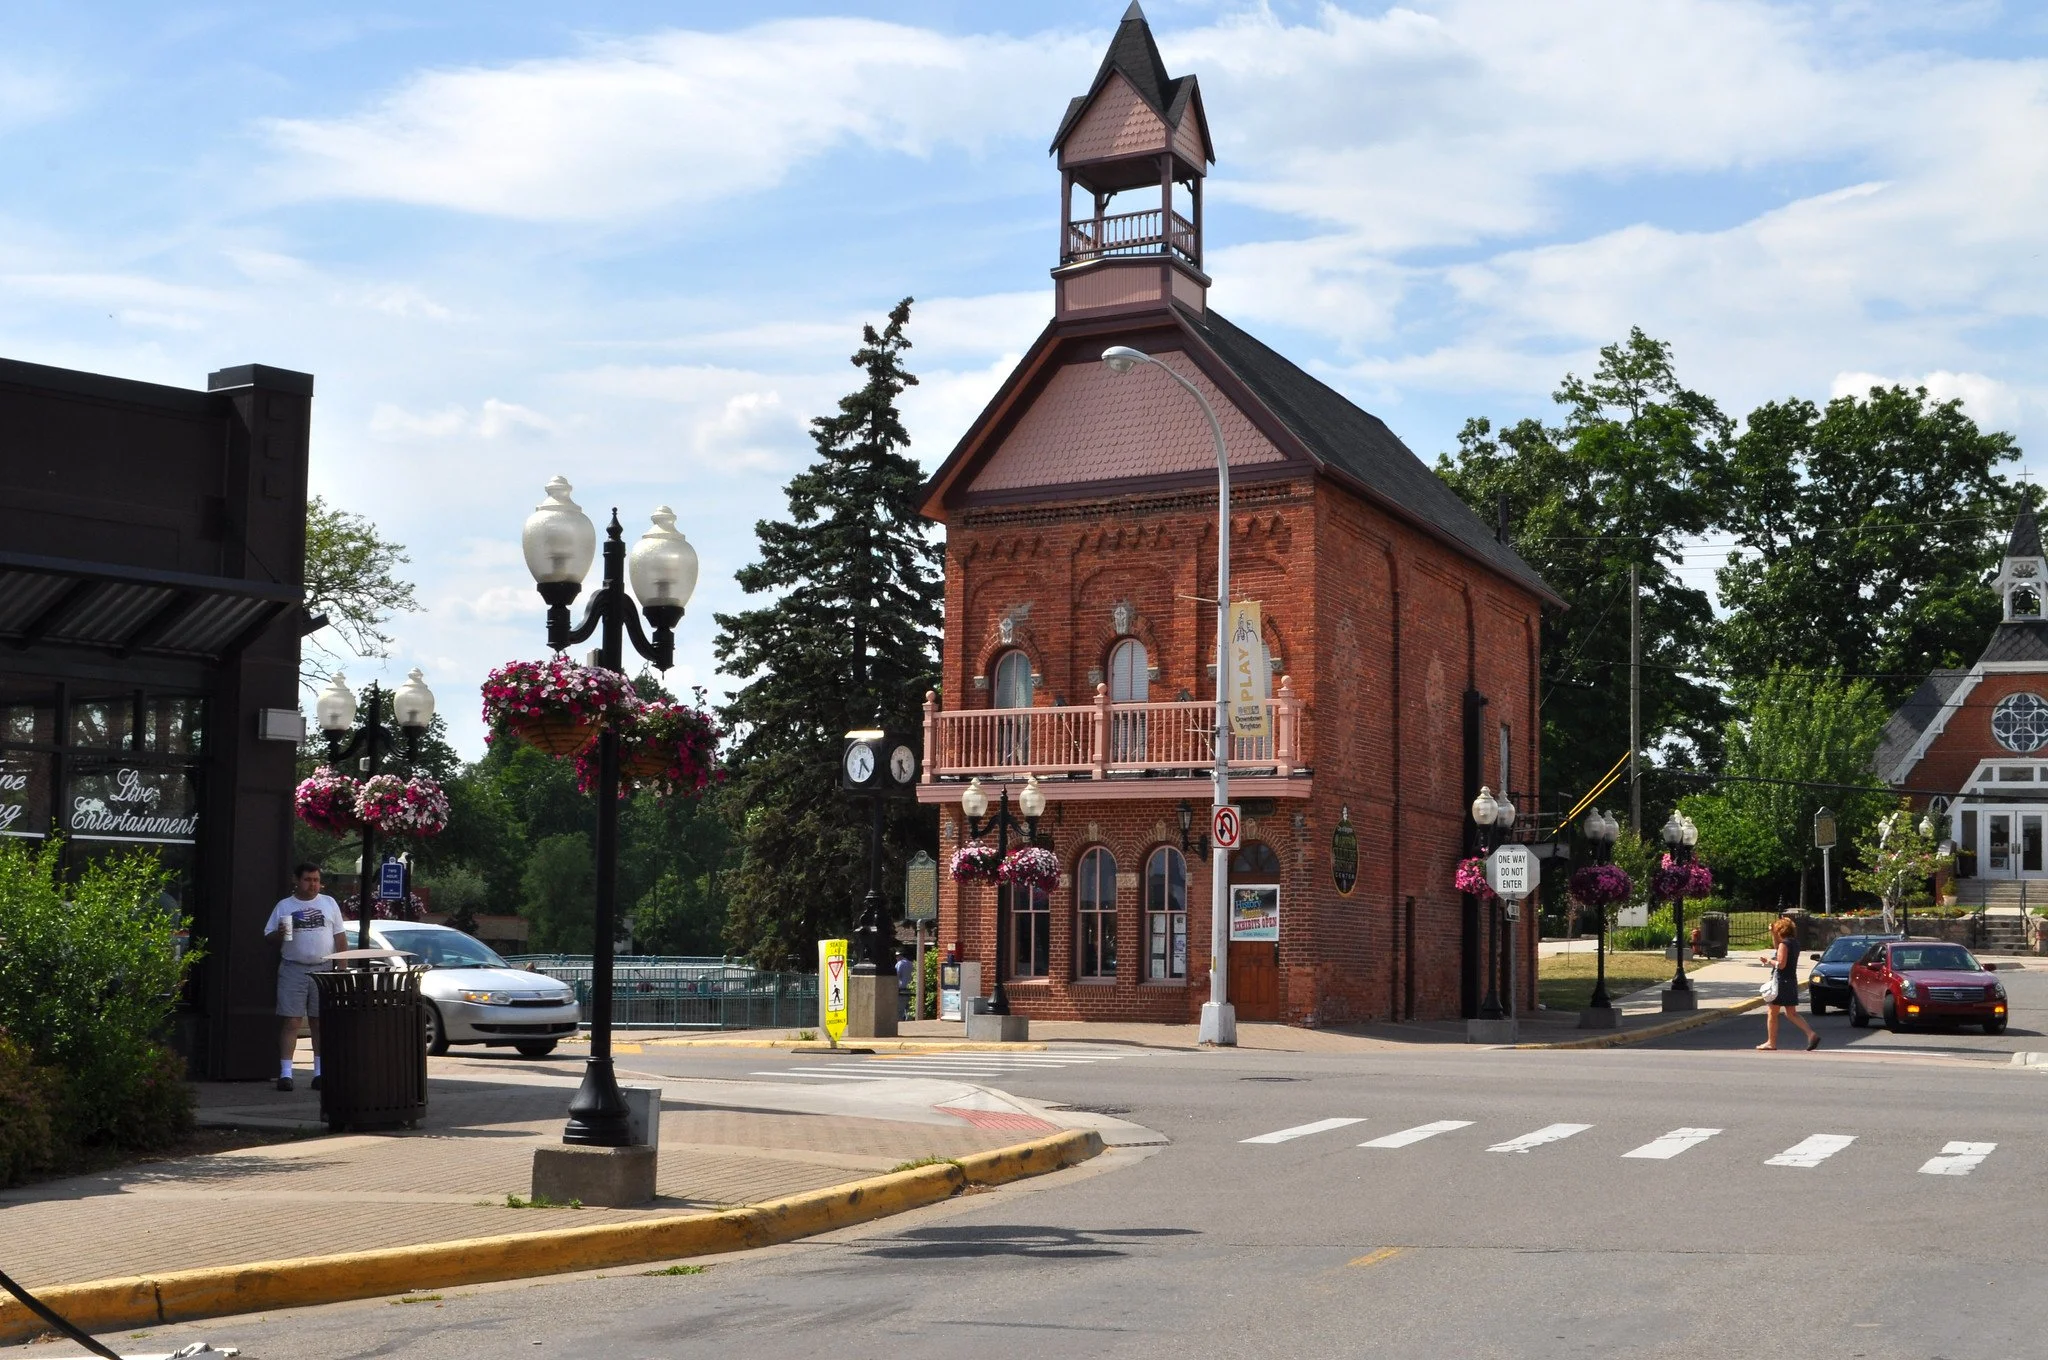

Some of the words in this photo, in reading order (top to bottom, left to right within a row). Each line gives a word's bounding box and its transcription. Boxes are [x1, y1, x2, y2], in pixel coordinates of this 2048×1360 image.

[1238, 647, 1254, 702] PLAY
[1235, 715, 1263, 723] Downtown
[1239, 723, 1262, 731] Brighton
[109, 768, 155, 802] Live
[71, 796, 199, 835] Entertainment
[1498, 855, 1511, 864] ONE
[1512, 855, 1526, 864] WAY
[1501, 867, 1510, 876] DO
[1511, 867, 1524, 876] NOT
[1502, 879, 1522, 889] ENTER
[1234, 919, 1260, 931] EXHIBITS
[1261, 916, 1277, 928] OPEN
